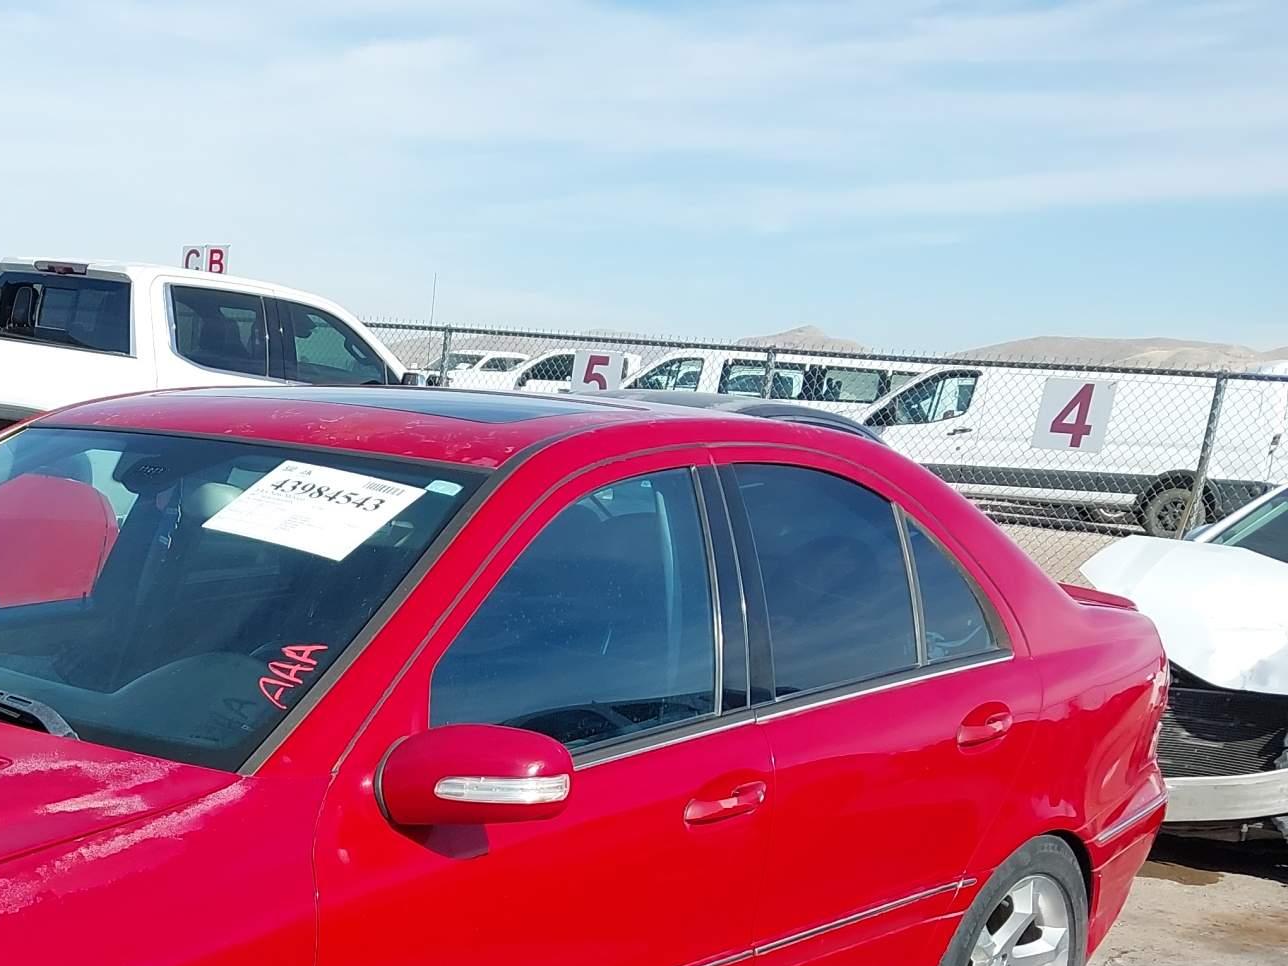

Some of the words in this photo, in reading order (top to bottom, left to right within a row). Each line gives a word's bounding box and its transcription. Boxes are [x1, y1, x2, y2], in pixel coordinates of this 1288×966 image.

[185, 249, 200, 270] C
[209, 249, 224, 274] B
[583, 355, 610, 390] 5
[1049, 383, 1095, 448] 4
[271, 478, 386, 511] 43984543
[259, 645, 329, 709] AAA
